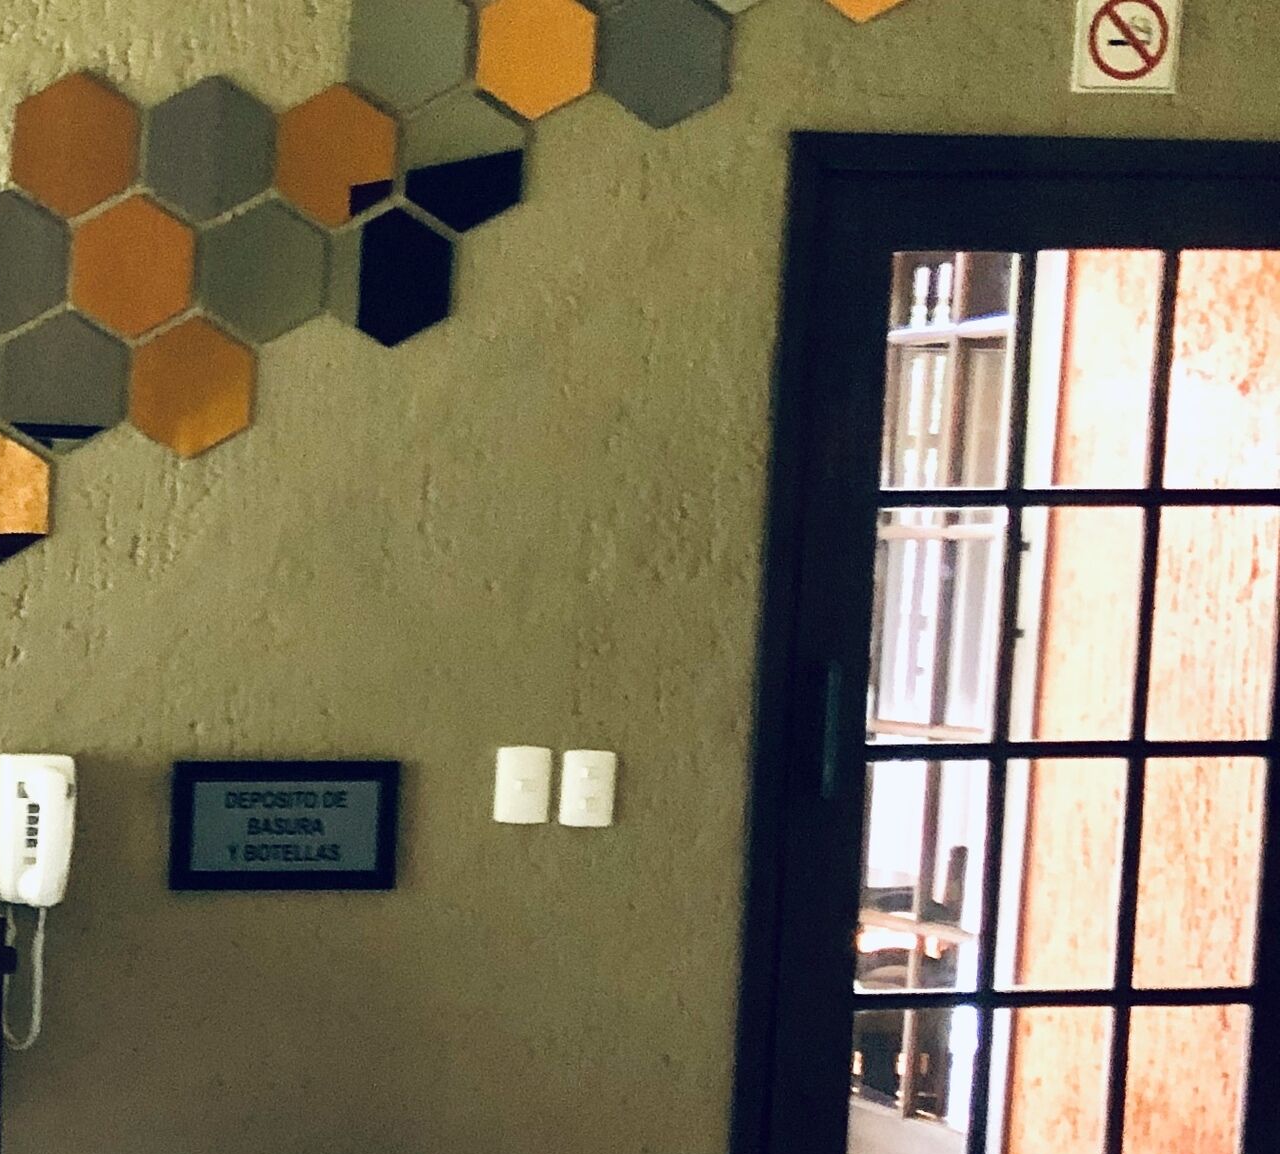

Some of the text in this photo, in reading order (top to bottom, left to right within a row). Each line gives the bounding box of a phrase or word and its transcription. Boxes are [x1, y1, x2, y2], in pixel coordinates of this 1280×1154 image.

[225, 790, 348, 809] DEPOSITO DE
[246, 817, 325, 836] BASURA
[227, 844, 340, 862] Y BOTELLAS
